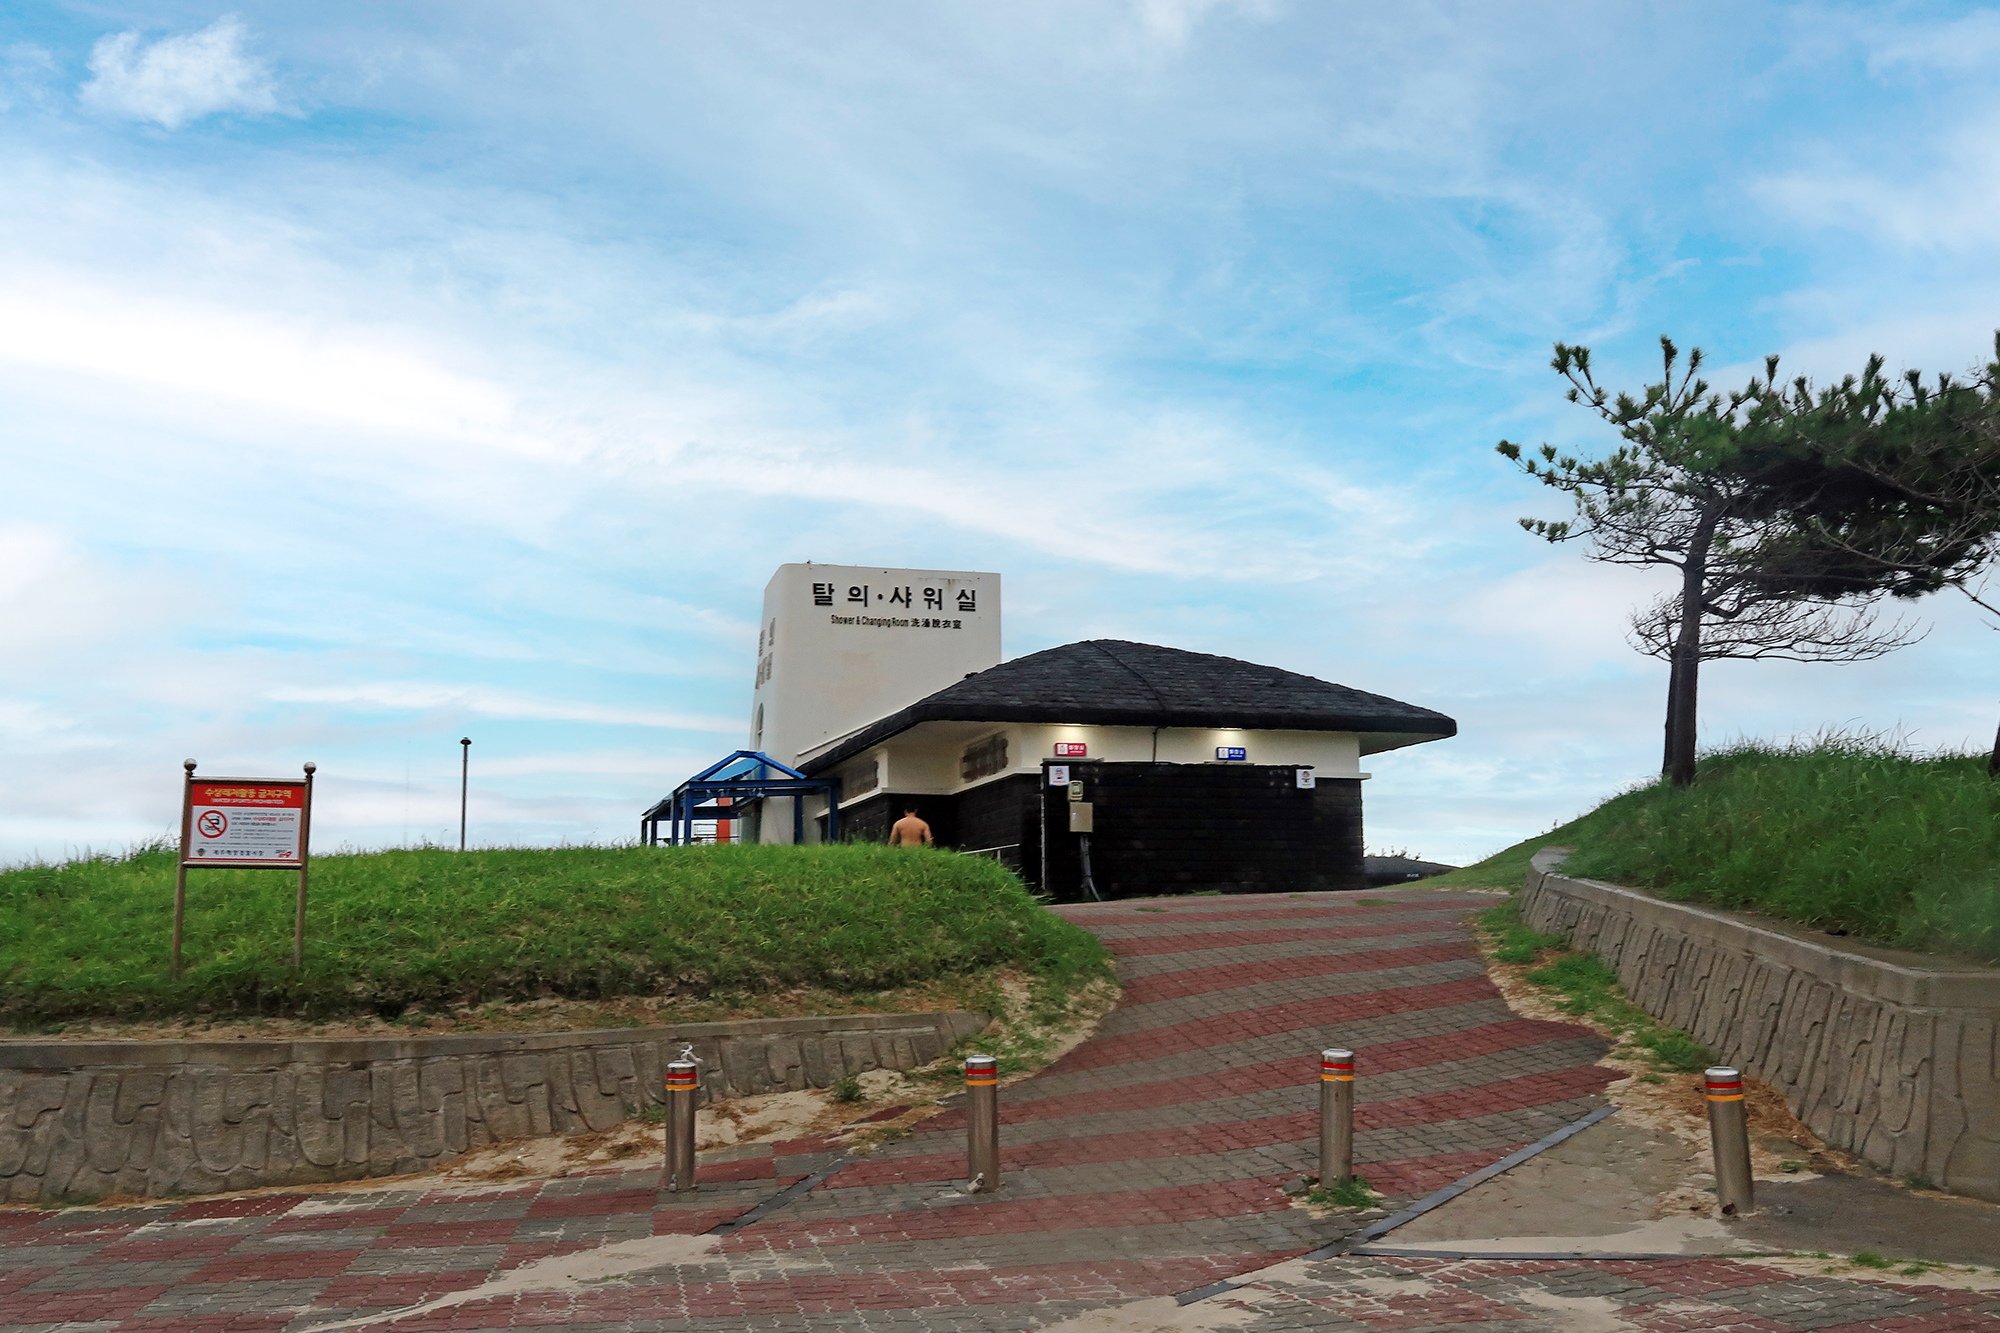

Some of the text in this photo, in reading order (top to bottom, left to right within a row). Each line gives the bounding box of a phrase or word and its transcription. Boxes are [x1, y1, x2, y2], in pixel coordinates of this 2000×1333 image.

[830, 614, 909, 628] Shower & Changing Room
